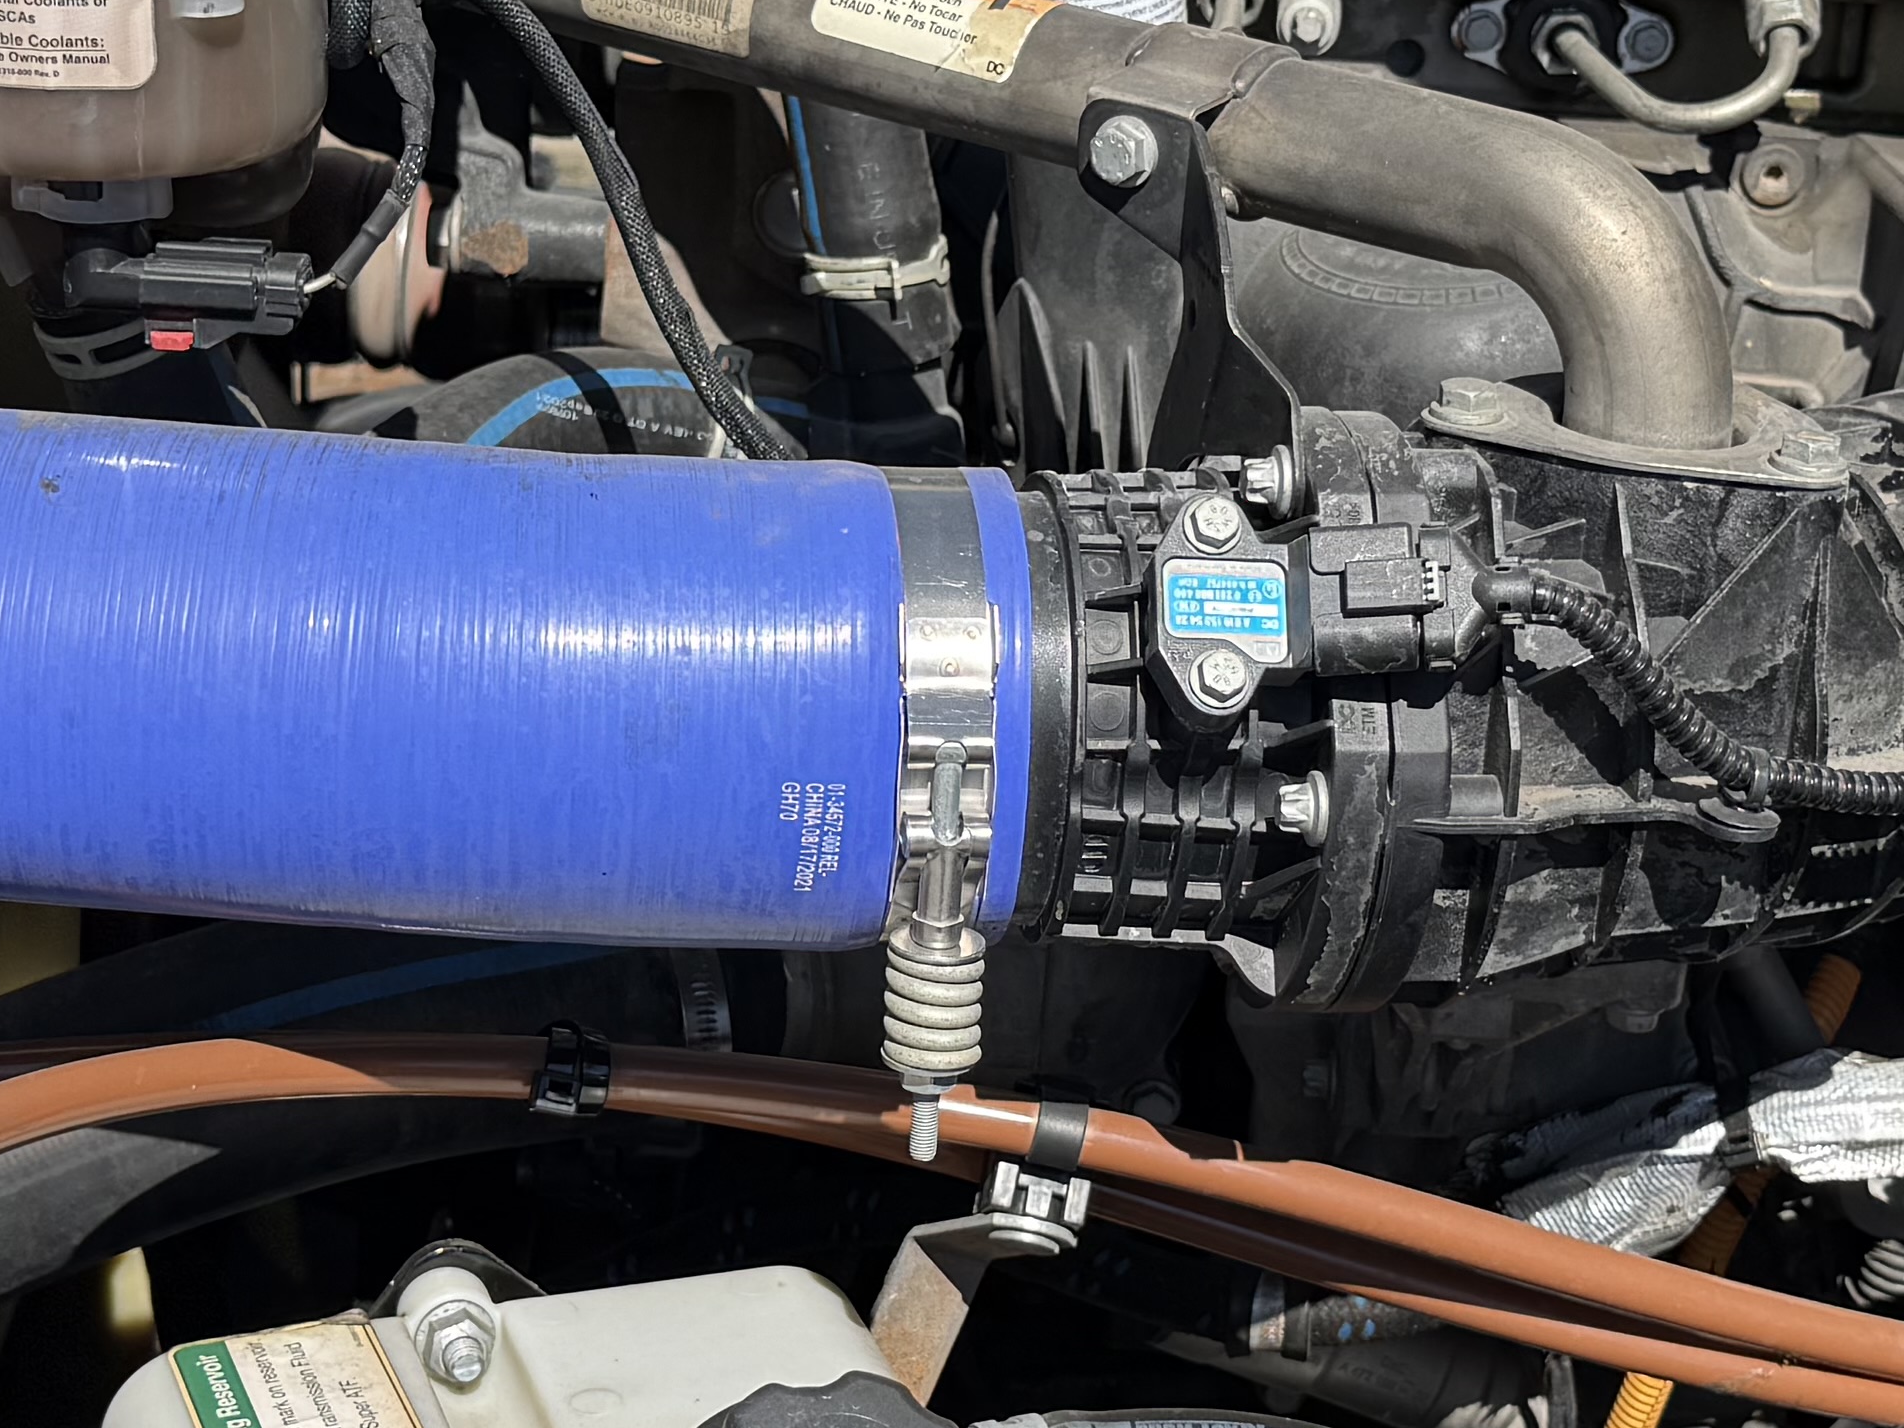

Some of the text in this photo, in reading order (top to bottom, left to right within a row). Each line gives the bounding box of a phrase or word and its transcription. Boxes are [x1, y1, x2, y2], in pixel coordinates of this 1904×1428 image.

[884, 10, 902, 23] Ne
[903, 13, 926, 31] Pas
[908, 0, 928, 15] No
[929, 5, 964, 23] Tocar
[28, 34, 105, 50] Coolants:
[9, 51, 58, 65] Owners
[62, 52, 111, 65] Manual
[986, 60, 1005, 76] DC
[779, 781, 801, 822] GH70
[822, 783, 847, 854] 01-34572-000
[793, 781, 825, 894] CHINA 08/17/2021
[247, 1338, 279, 1386] reservoir.
[283, 1340, 310, 1369] Fluid
[196, 1353, 242, 1420] Reservoir
[268, 1384, 287, 1400] on
[337, 1375, 365, 1402] ATF.
[274, 1397, 300, 1427] mark
